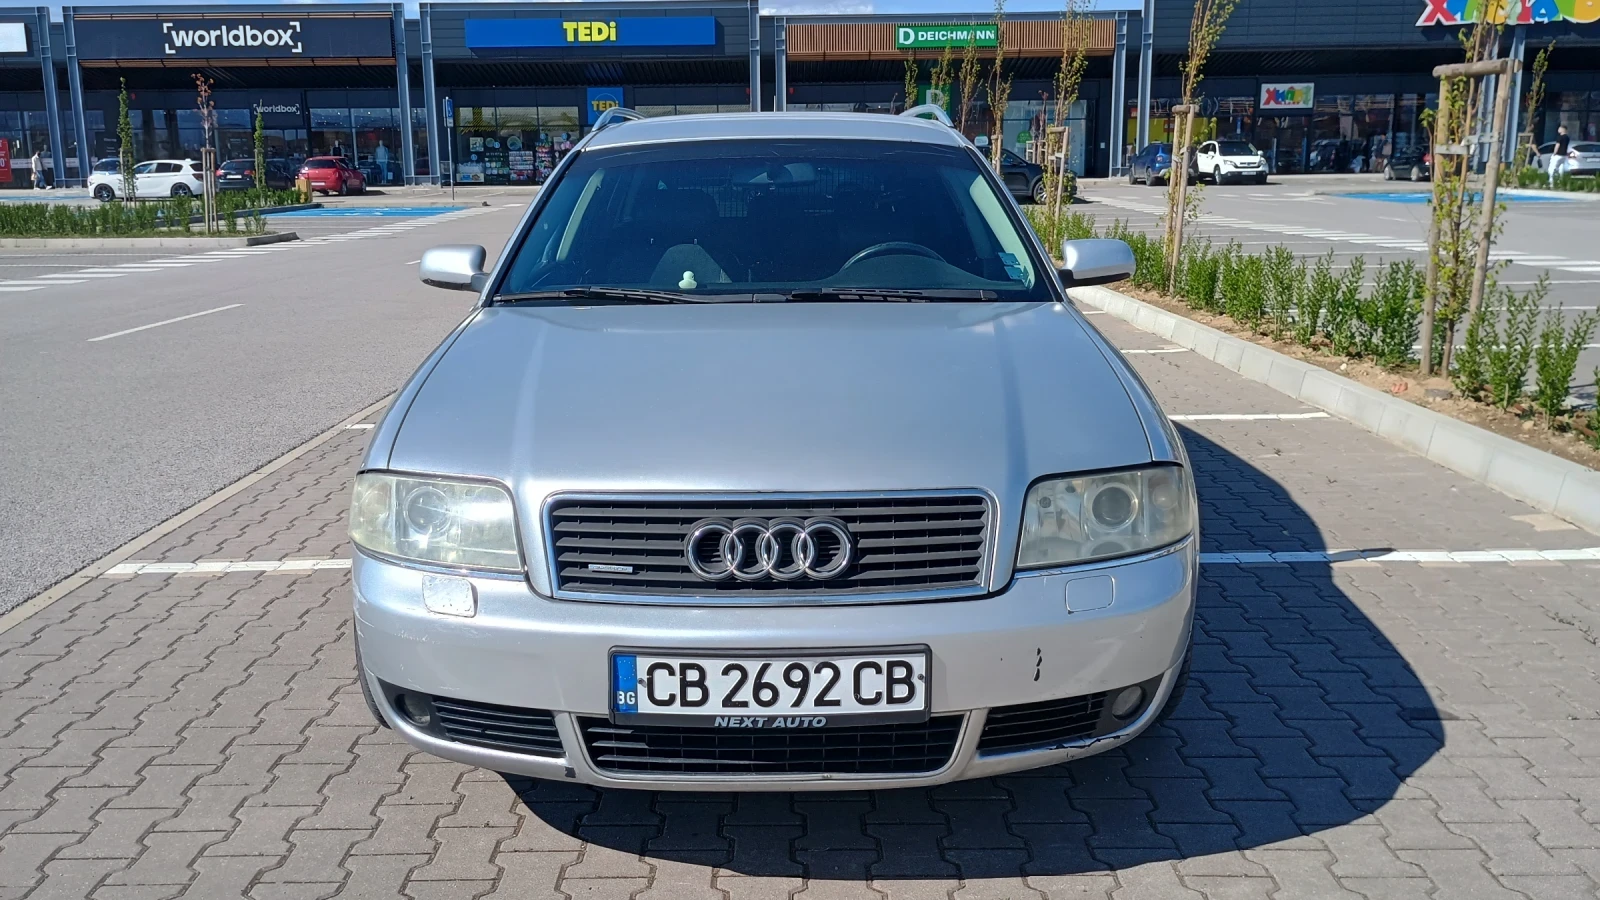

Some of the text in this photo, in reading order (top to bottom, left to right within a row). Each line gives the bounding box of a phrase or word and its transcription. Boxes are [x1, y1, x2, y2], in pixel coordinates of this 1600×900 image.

[171, 25, 294, 46] worldbox
[563, 21, 617, 41] TEDi
[918, 30, 995, 41] DEICHMANN
[255, 104, 297, 113] worldbox
[646, 659, 916, 708] CB 2692 CB
[714, 716, 827, 728] NEXT AUTO
